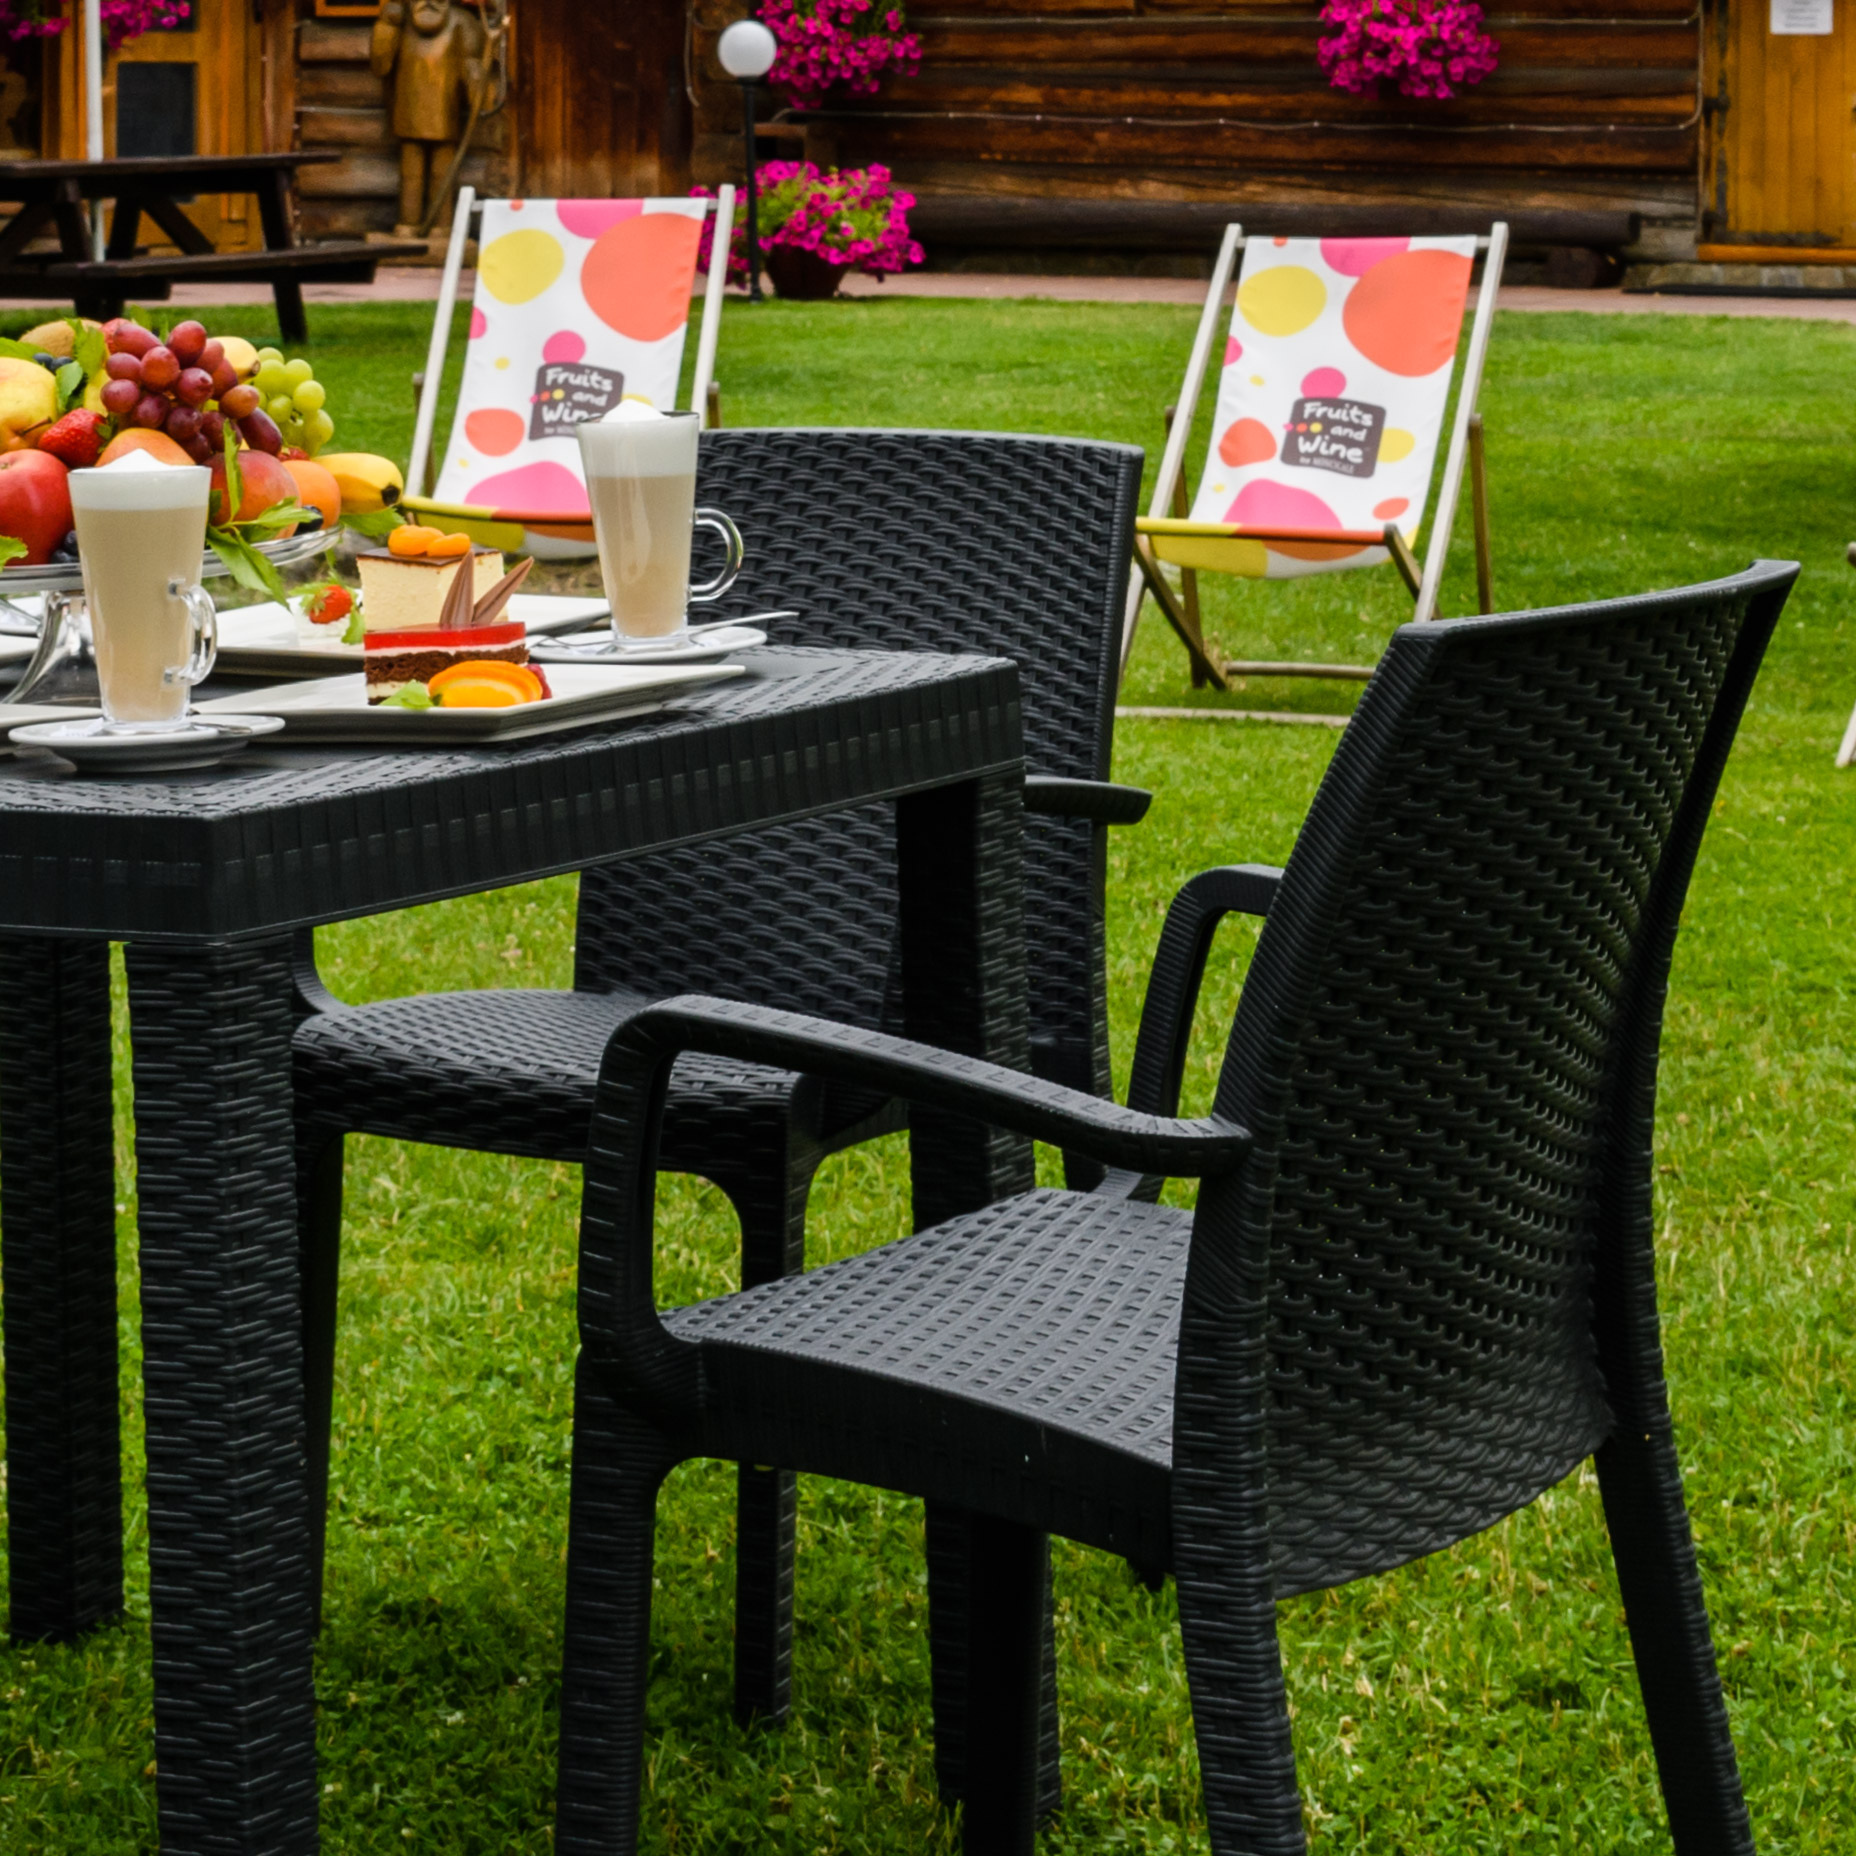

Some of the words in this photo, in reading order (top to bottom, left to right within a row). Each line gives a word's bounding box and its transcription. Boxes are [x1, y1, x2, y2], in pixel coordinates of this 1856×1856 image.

[545, 366, 613, 392] Fruits
[571, 390, 608, 407] and
[1303, 401, 1373, 427] Fruits
[1330, 425, 1367, 442] and
[1297, 434, 1364, 464] Wine
